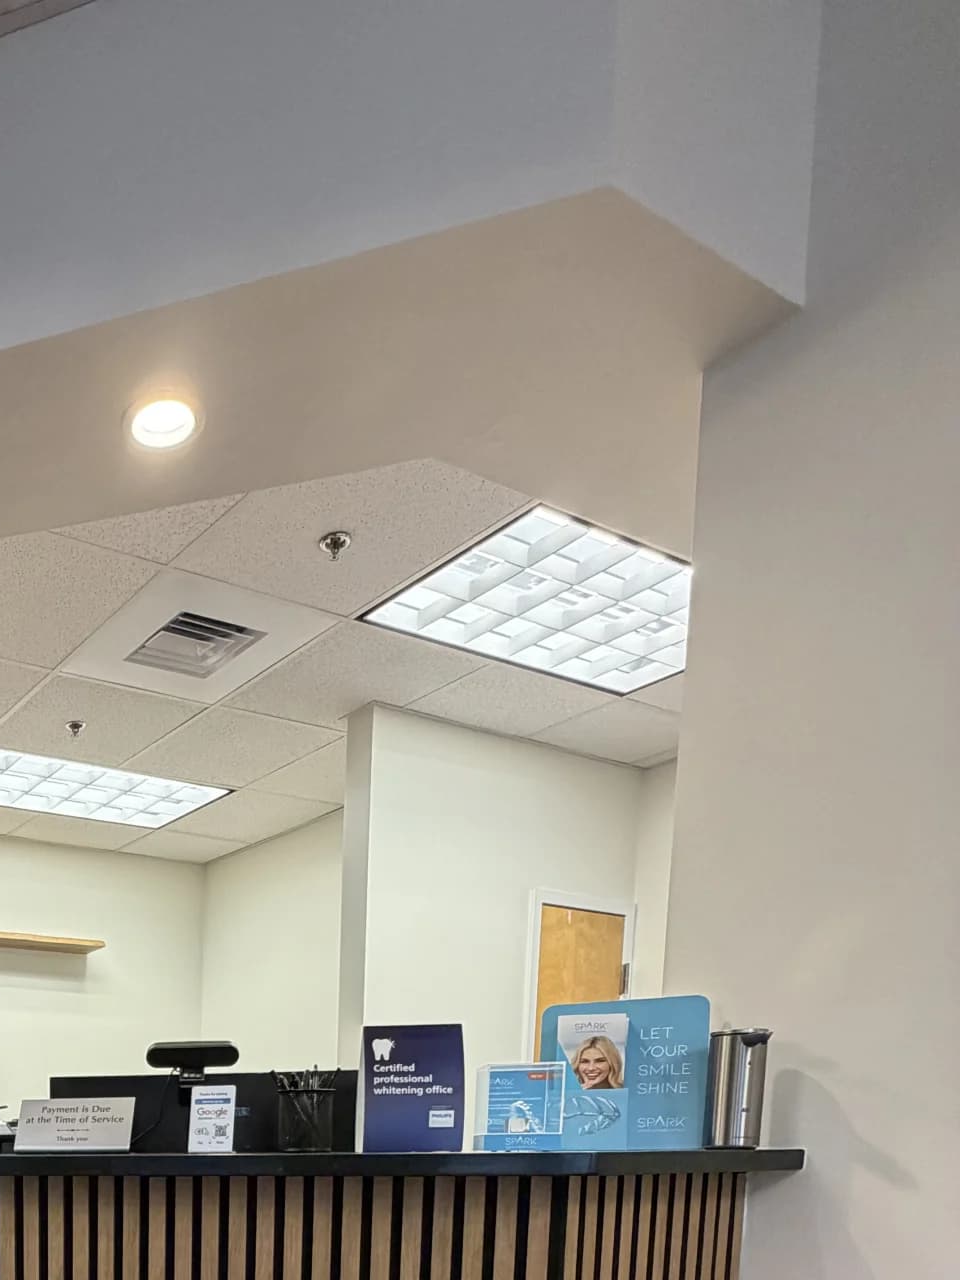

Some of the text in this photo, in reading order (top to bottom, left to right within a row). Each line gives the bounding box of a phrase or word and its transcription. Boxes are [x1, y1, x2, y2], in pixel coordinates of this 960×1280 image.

[574, 1022, 609, 1032] SPARK
[640, 1027, 673, 1040] LET
[640, 1045, 688, 1058] YOUR
[373, 1063, 416, 1073] Certified
[638, 1063, 691, 1076] SMILE
[373, 1074, 433, 1085] professional
[373, 1086, 453, 1097] whitening office
[637, 1082, 689, 1095] SHINE
[41, 1105, 111, 1114] Payment is Due
[197, 1107, 228, 1118] Google
[37, 1116, 51, 1124] the
[54, 1116, 77, 1124] Time
[79, 1116, 89, 1124] of
[90, 1115, 124, 1123] Service
[637, 1115, 687, 1128] SPARK
[505, 1136, 537, 1146] SPARK
